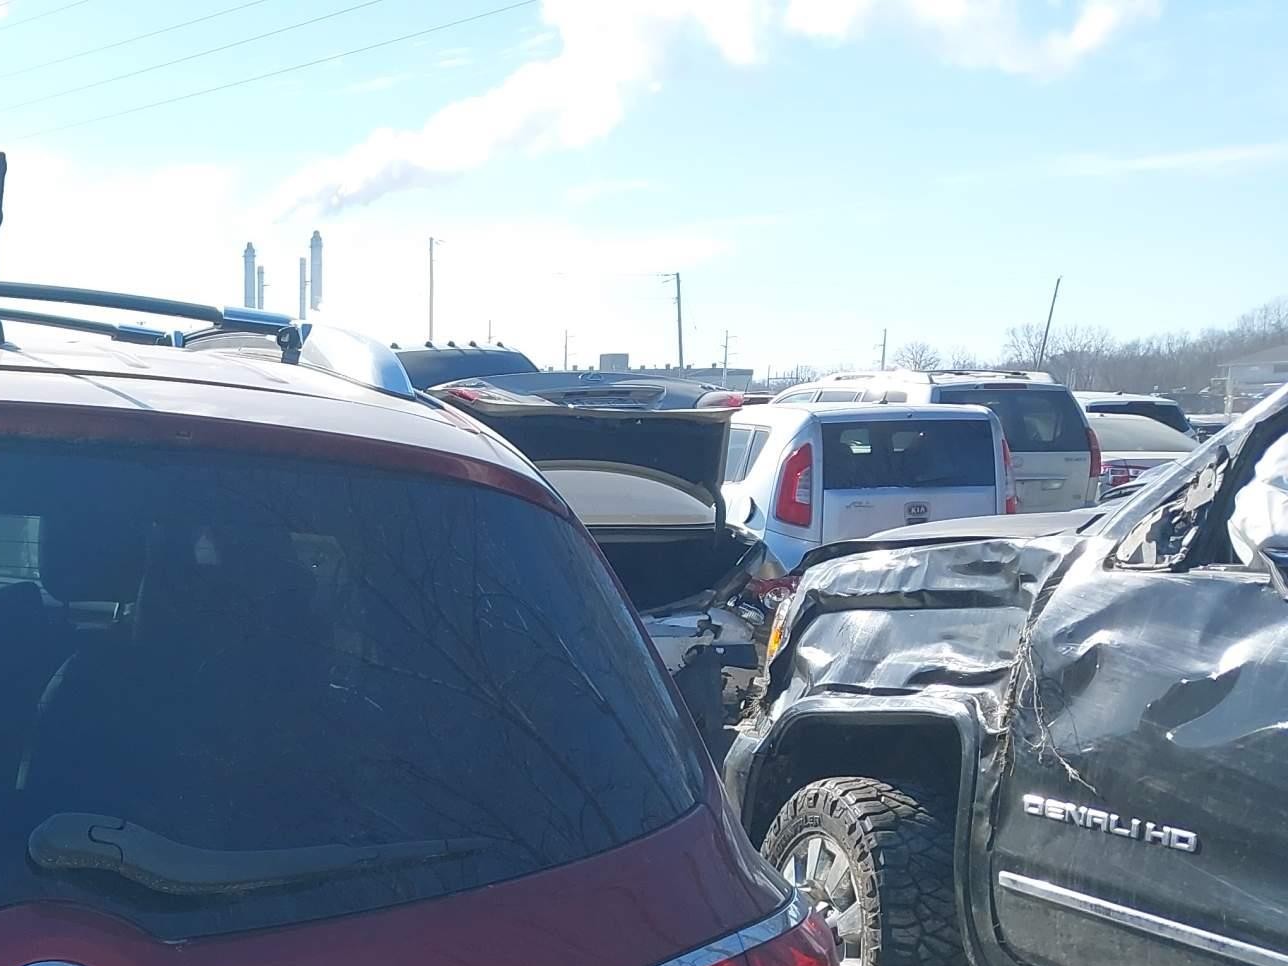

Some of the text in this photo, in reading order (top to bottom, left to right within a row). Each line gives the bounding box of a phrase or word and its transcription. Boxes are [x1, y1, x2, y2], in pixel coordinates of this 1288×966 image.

[910, 505, 927, 515] KIA
[1023, 794, 1198, 852] DENALI HD
